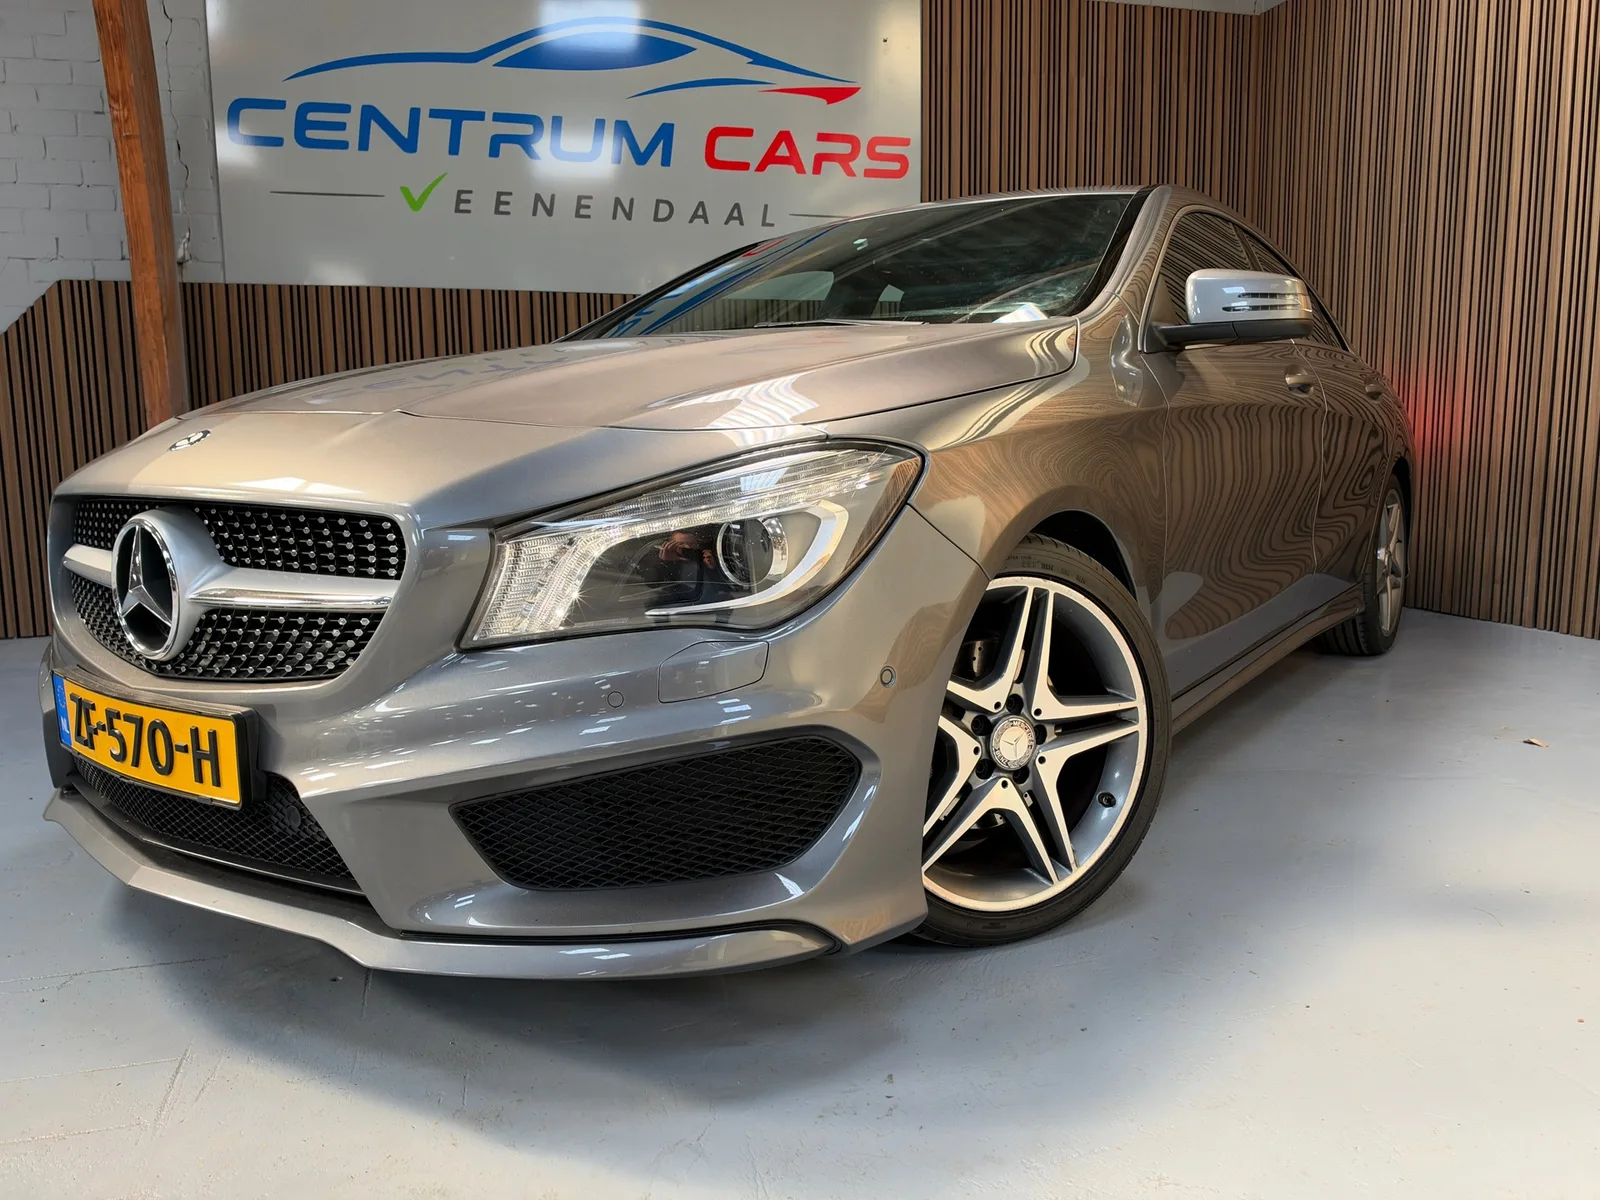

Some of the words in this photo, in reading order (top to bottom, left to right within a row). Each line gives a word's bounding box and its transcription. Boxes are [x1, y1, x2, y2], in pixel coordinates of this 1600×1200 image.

[227, 97, 676, 168] CENTRUM
[704, 125, 911, 180] CARS
[60, 715, 70, 734] NL
[69, 692, 221, 787] ZF-570-H
